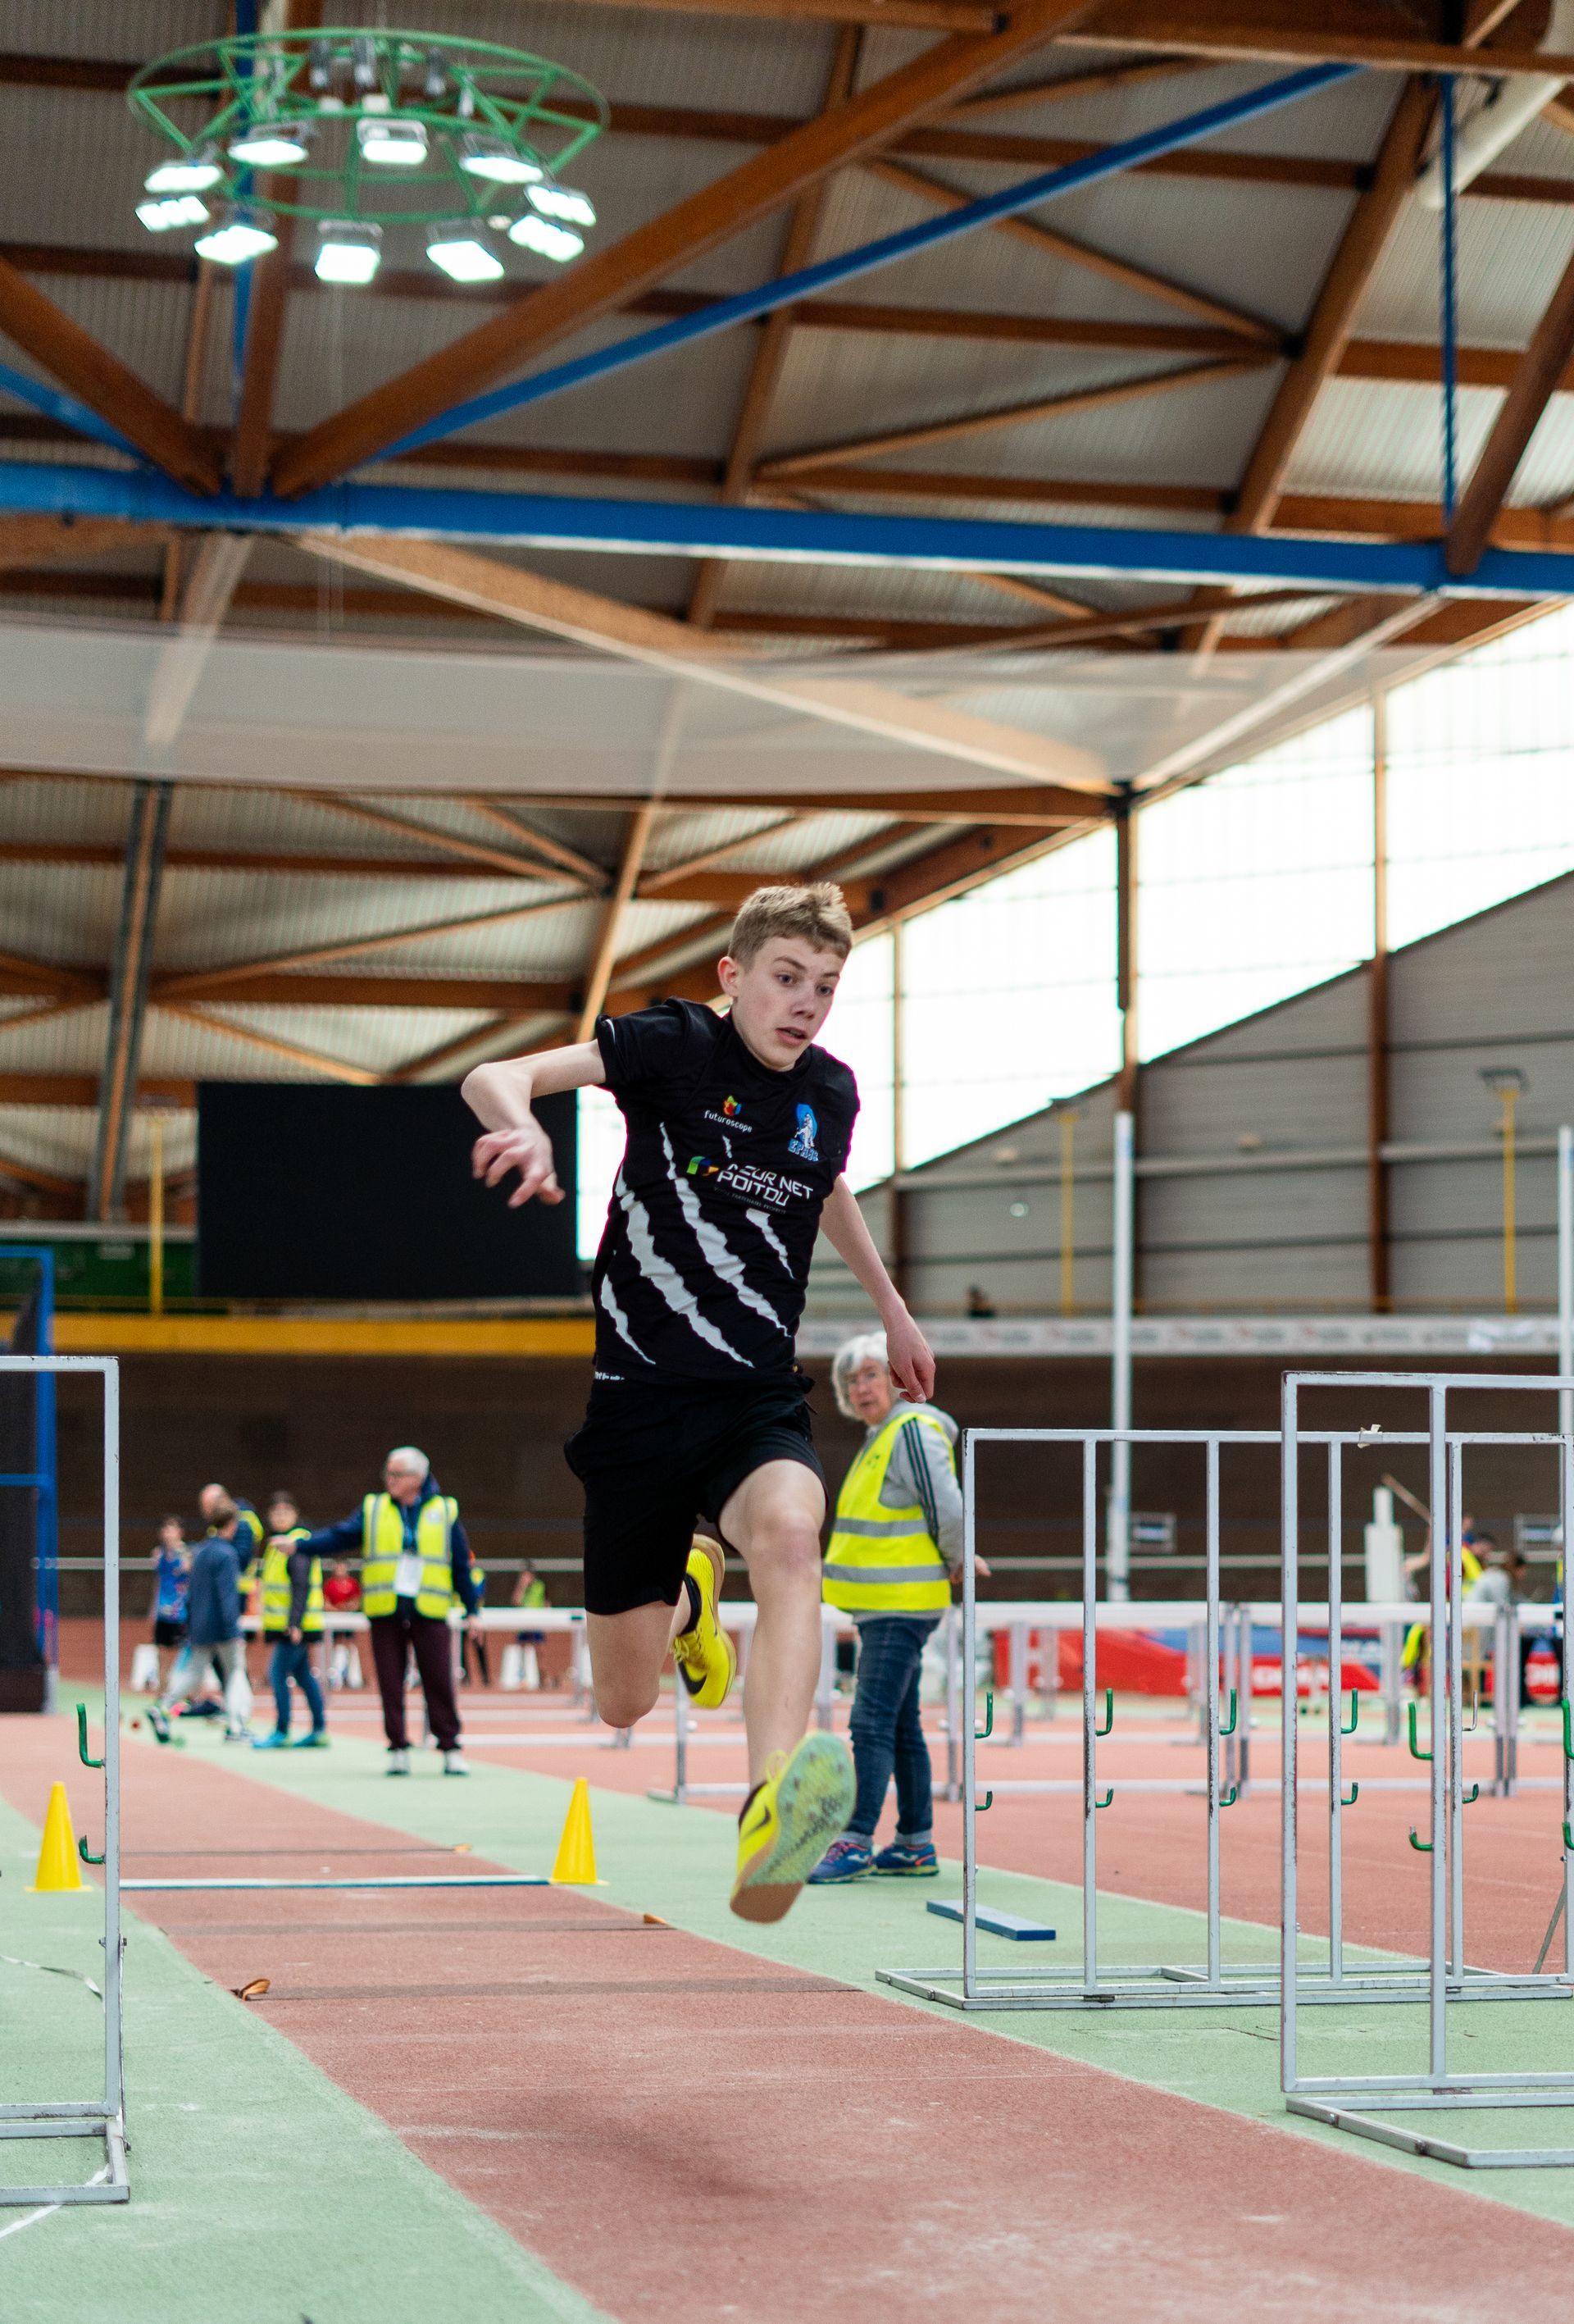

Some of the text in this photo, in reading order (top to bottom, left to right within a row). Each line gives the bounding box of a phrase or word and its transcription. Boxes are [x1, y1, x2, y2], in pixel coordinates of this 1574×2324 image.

[704, 1110, 753, 1132] futuroscope
[716, 1171, 790, 1206] POITOU
[780, 1176, 813, 1200] NET
